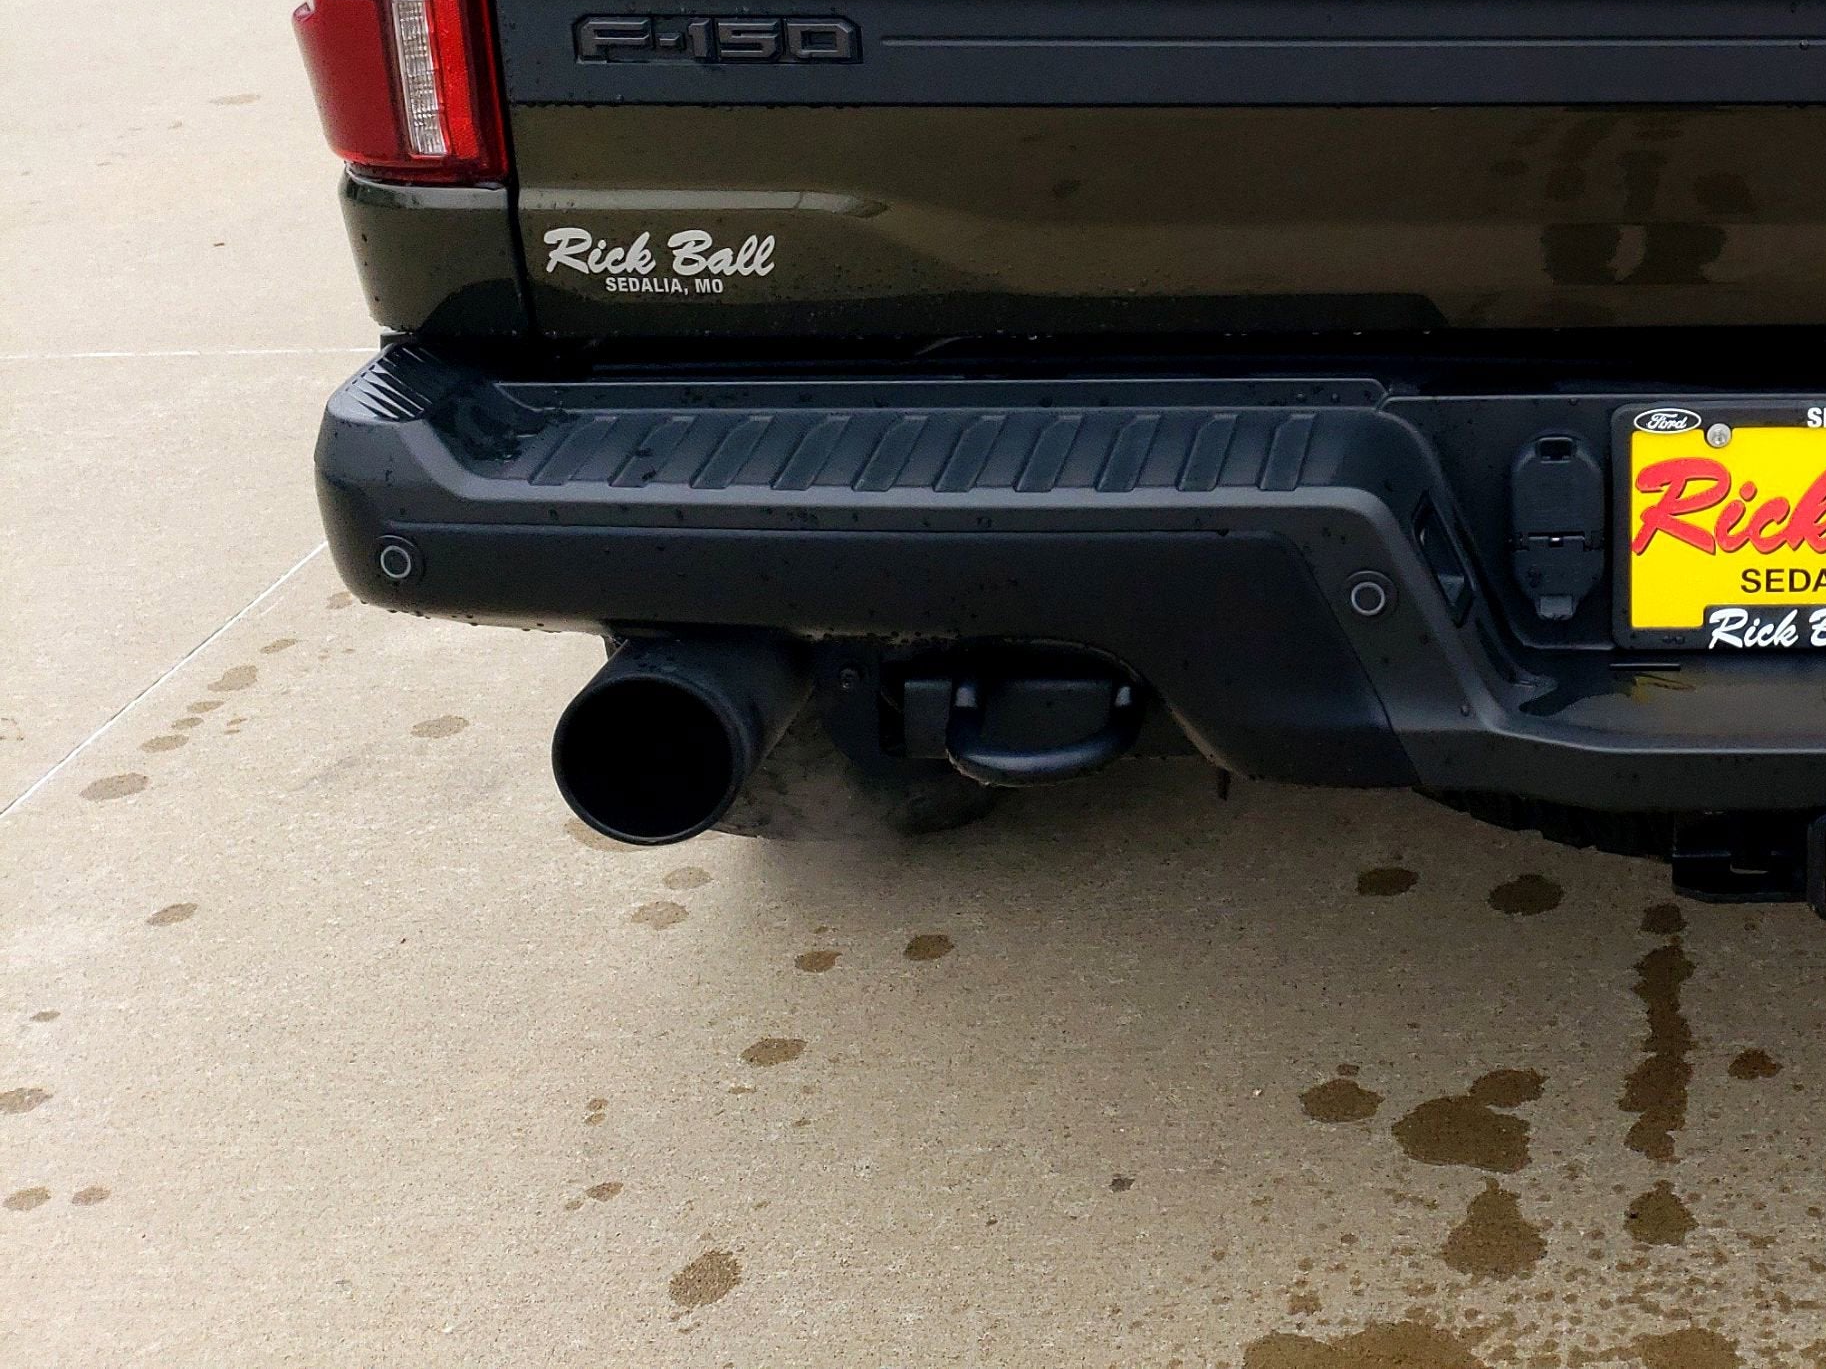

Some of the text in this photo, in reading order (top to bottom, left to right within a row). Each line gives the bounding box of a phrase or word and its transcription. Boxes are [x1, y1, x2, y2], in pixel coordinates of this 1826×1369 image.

[580, 18, 856, 60] F-150
[543, 228, 776, 276] Rick Ball
[605, 277, 724, 296] SEDALIA, MO
[1647, 412, 1688, 430] Ford
[1708, 607, 1799, 649] Rick
